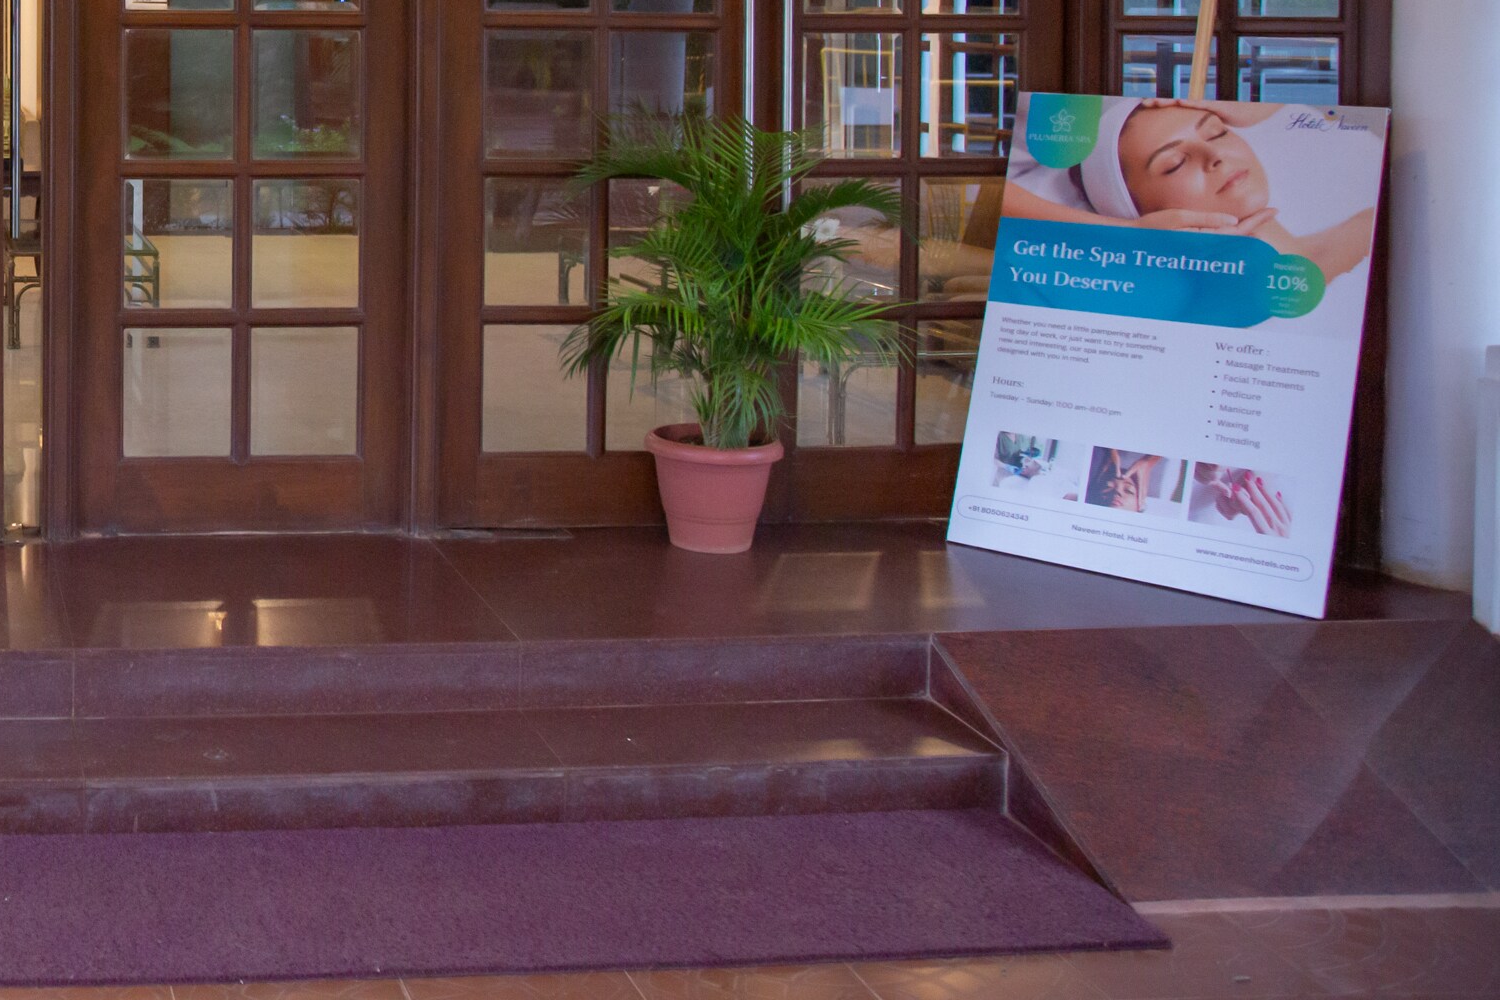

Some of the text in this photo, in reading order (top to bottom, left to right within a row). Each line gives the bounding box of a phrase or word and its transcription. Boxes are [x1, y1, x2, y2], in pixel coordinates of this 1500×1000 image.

[1284, 112, 1323, 131] Hotel
[1028, 133, 1092, 143] PLUMERIA SPA
[1013, 239, 1246, 276] Get the Spa Treatment
[1009, 266, 1135, 294] You Deserve
[1266, 274, 1309, 292] 10%
[1016, 328, 1030, 336] day
[1126, 342, 1166, 353] something
[1091, 328, 1131, 339] pampering
[1132, 332, 1150, 340] after
[1030, 350, 1045, 358] with
[1099, 349, 1129, 358] services
[1215, 342, 1234, 352] We
[1236, 344, 1264, 355] offer
[1225, 360, 1320, 378] Massage Treatments
[992, 376, 1025, 388] Hours:
[1223, 374, 1306, 391] Facial Treatments
[990, 391, 1019, 402] Tuesday
[1221, 389, 1262, 401] Pedicure
[1219, 404, 1262, 416] Manicure
[1217, 419, 1249, 432] Waxing
[1215, 434, 1260, 449] Threading
[1071, 524, 1101, 535] Naveen
[1196, 548, 1299, 573] www.naveenhotels.com
